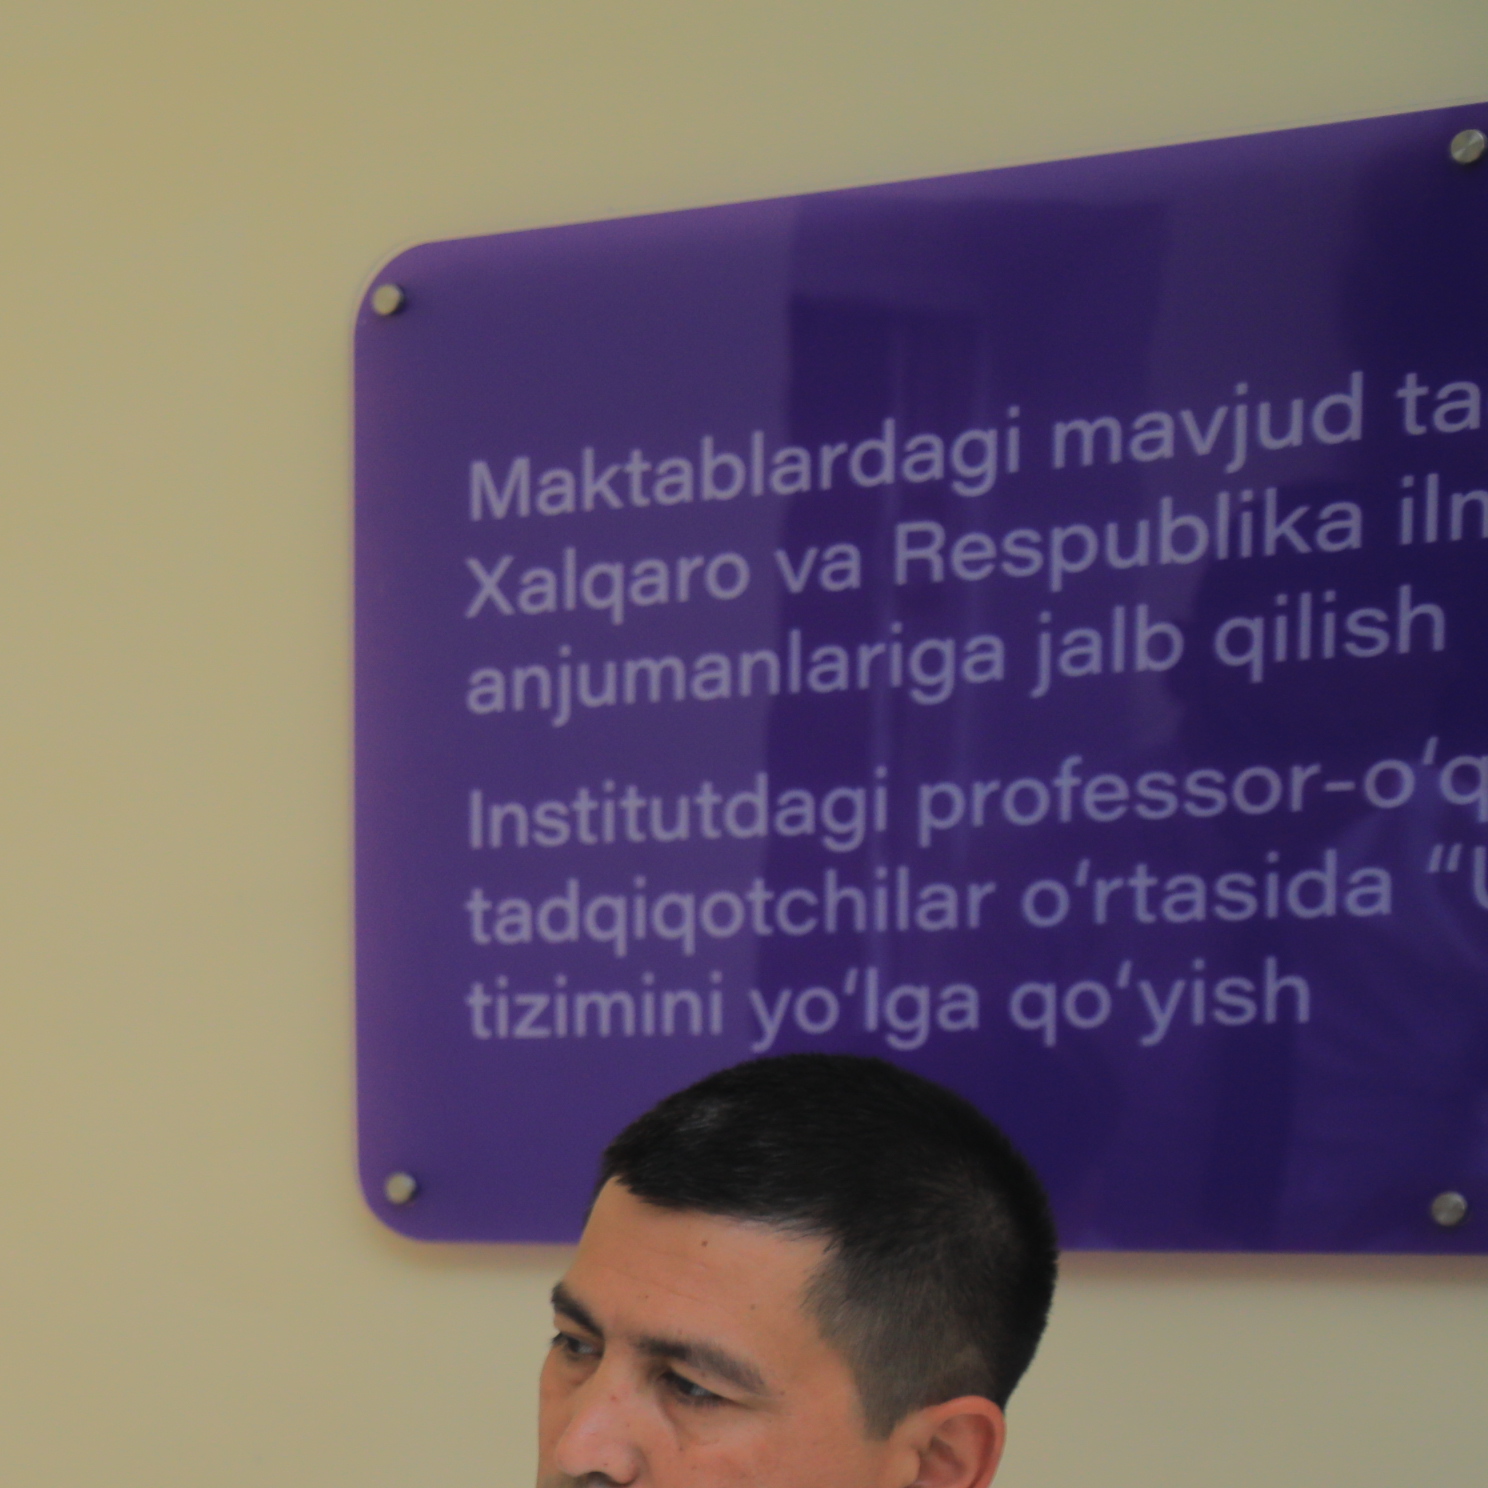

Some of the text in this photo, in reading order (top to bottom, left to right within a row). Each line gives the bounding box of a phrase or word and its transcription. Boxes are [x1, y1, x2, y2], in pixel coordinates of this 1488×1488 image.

[469, 370, 1482, 522] Maktablardagi mavjud ta
[465, 546, 751, 625] Xalqaro
[774, 542, 862, 593] va
[893, 487, 1363, 593] Respublika
[466, 584, 1446, 728] anjumanlariga jalb qilish
[469, 764, 888, 853] Institutdagi
[464, 865, 997, 957] tadqiqotchilar
[465, 970, 723, 1040] tizimini
